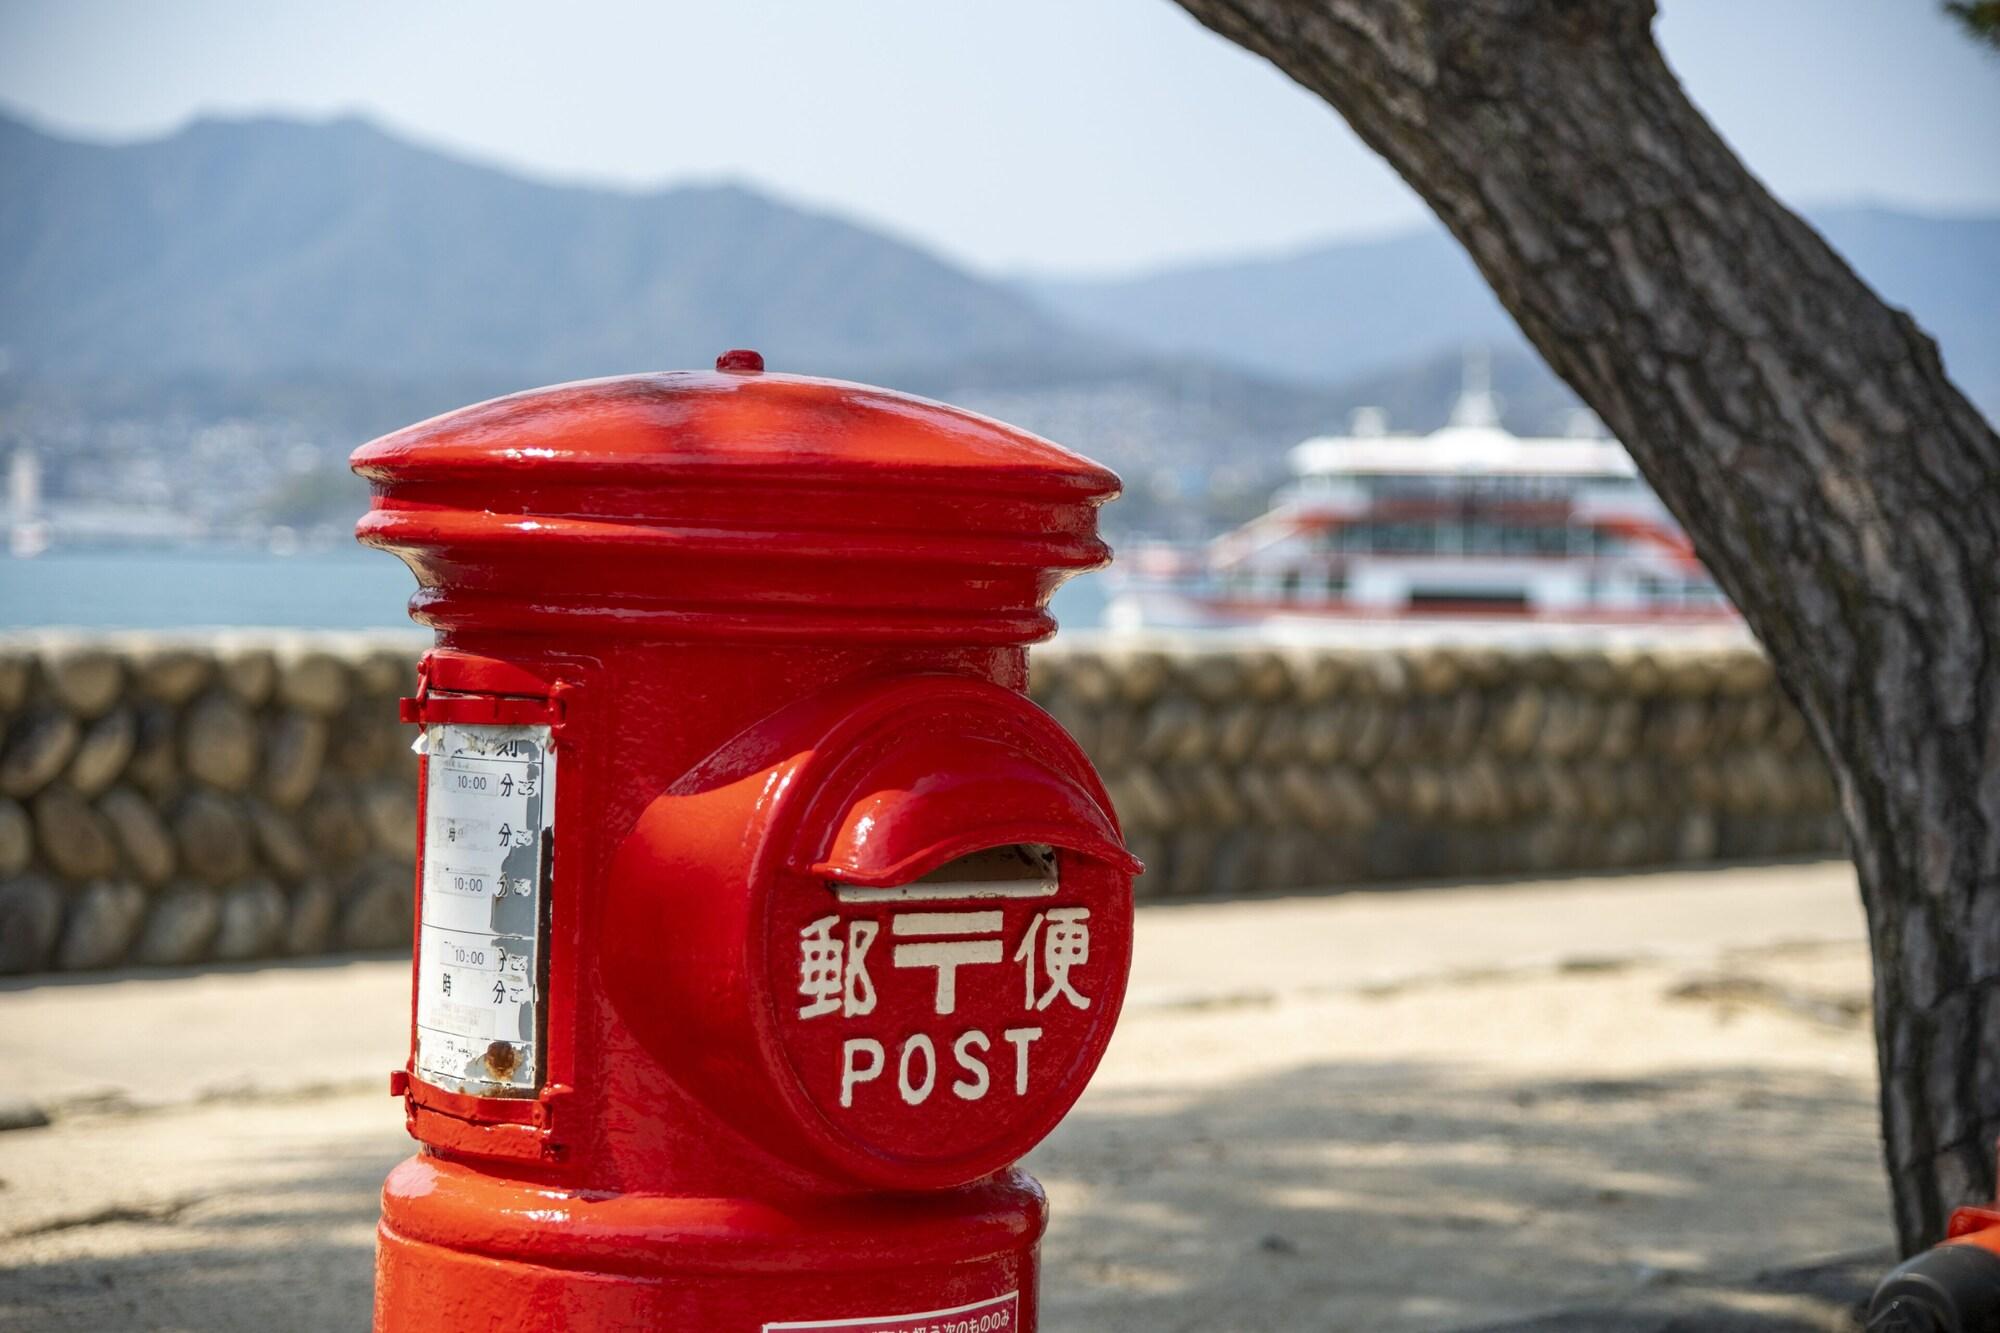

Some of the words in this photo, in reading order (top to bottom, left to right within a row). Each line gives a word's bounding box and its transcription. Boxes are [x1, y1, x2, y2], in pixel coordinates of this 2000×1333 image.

[457, 775, 487, 791] 10:00
[454, 877, 483, 893] 10:00
[455, 949, 485, 966] 10:00
[840, 1027, 1043, 1108] POST
